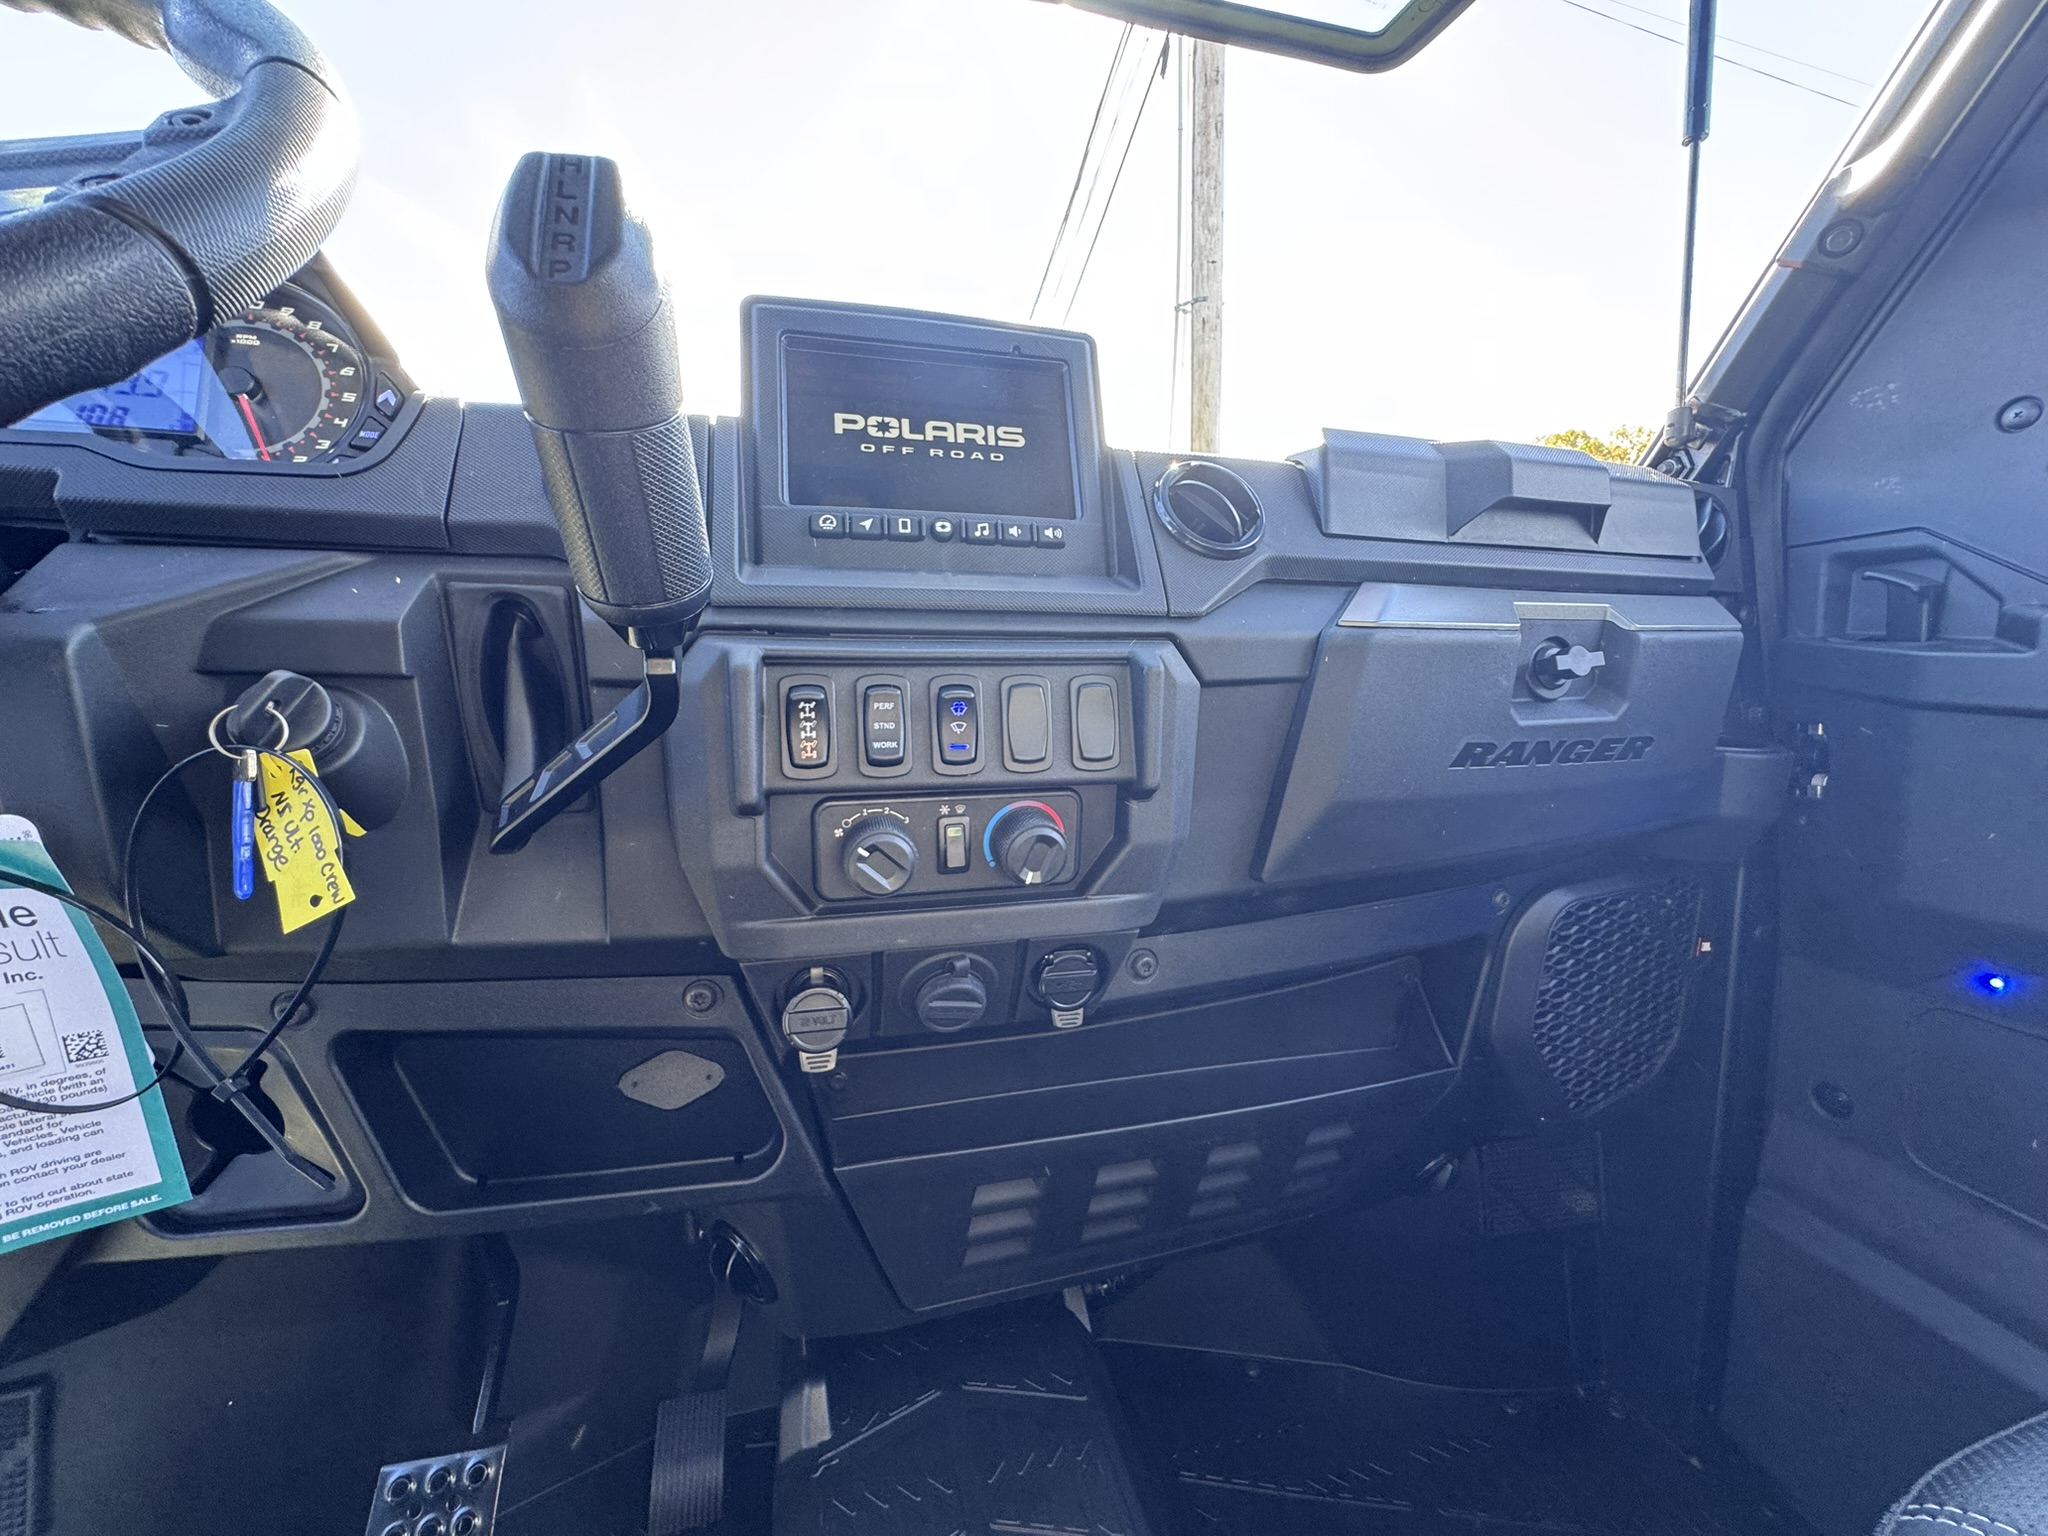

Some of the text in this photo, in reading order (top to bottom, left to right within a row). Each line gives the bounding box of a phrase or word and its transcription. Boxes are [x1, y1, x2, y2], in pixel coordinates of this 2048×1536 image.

[559, 156, 583, 174] H
[557, 179, 577, 200] L
[554, 206, 580, 225] N
[551, 233, 576, 252] R
[550, 260, 572, 278] P
[279, 306, 295, 317] 9
[306, 320, 323, 331] 8
[326, 343, 339, 353] 7
[339, 366, 356, 377] 6
[341, 392, 357, 403] 5
[333, 417, 349, 428] 4
[833, 412, 1027, 449] POLARIS
[358, 430, 380, 439] MODE
[315, 439, 331, 450] 3
[860, 443, 1005, 462] OFF ROAD
[873, 702, 895, 710] PERF
[873, 721, 896, 730] STND
[872, 741, 898, 749] WORK
[1448, 735, 1655, 770] RANGER
[862, 806, 910, 824] 1 2 3
[3, 971, 44, 984] Inc.
[26, 1082, 37, 1090] in
[41, 1072, 93, 1088] degrees,
[95, 1067, 107, 1076] of
[20, 1077, 104, 1100] ehicle (with an
[60, 1084, 108, 1102] pounds)
[3, 1120, 102, 1148] Vehicles. Vehicle
[47, 1120, 64, 1131] for
[9, 1144, 33, 1156] and
[36, 1132, 81, 1149] loading
[83, 1128, 104, 1139] can
[10, 1163, 37, 1177] ROV
[40, 1154, 85, 1170] driving
[84, 1149, 102, 1159] are
[13, 1167, 59, 1185] contact
[62, 1160, 88, 1174] your
[90, 1152, 126, 1166] dealer
[5, 1199, 18, 1208] to
[47, 1186, 67, 1197] out
[70, 1178, 104, 1192] about
[105, 1171, 134, 1183] state
[5, 1189, 96, 1217] ROV operation.
[2, 1193, 163, 1243] BE REMOVED BEFORE SALE.
